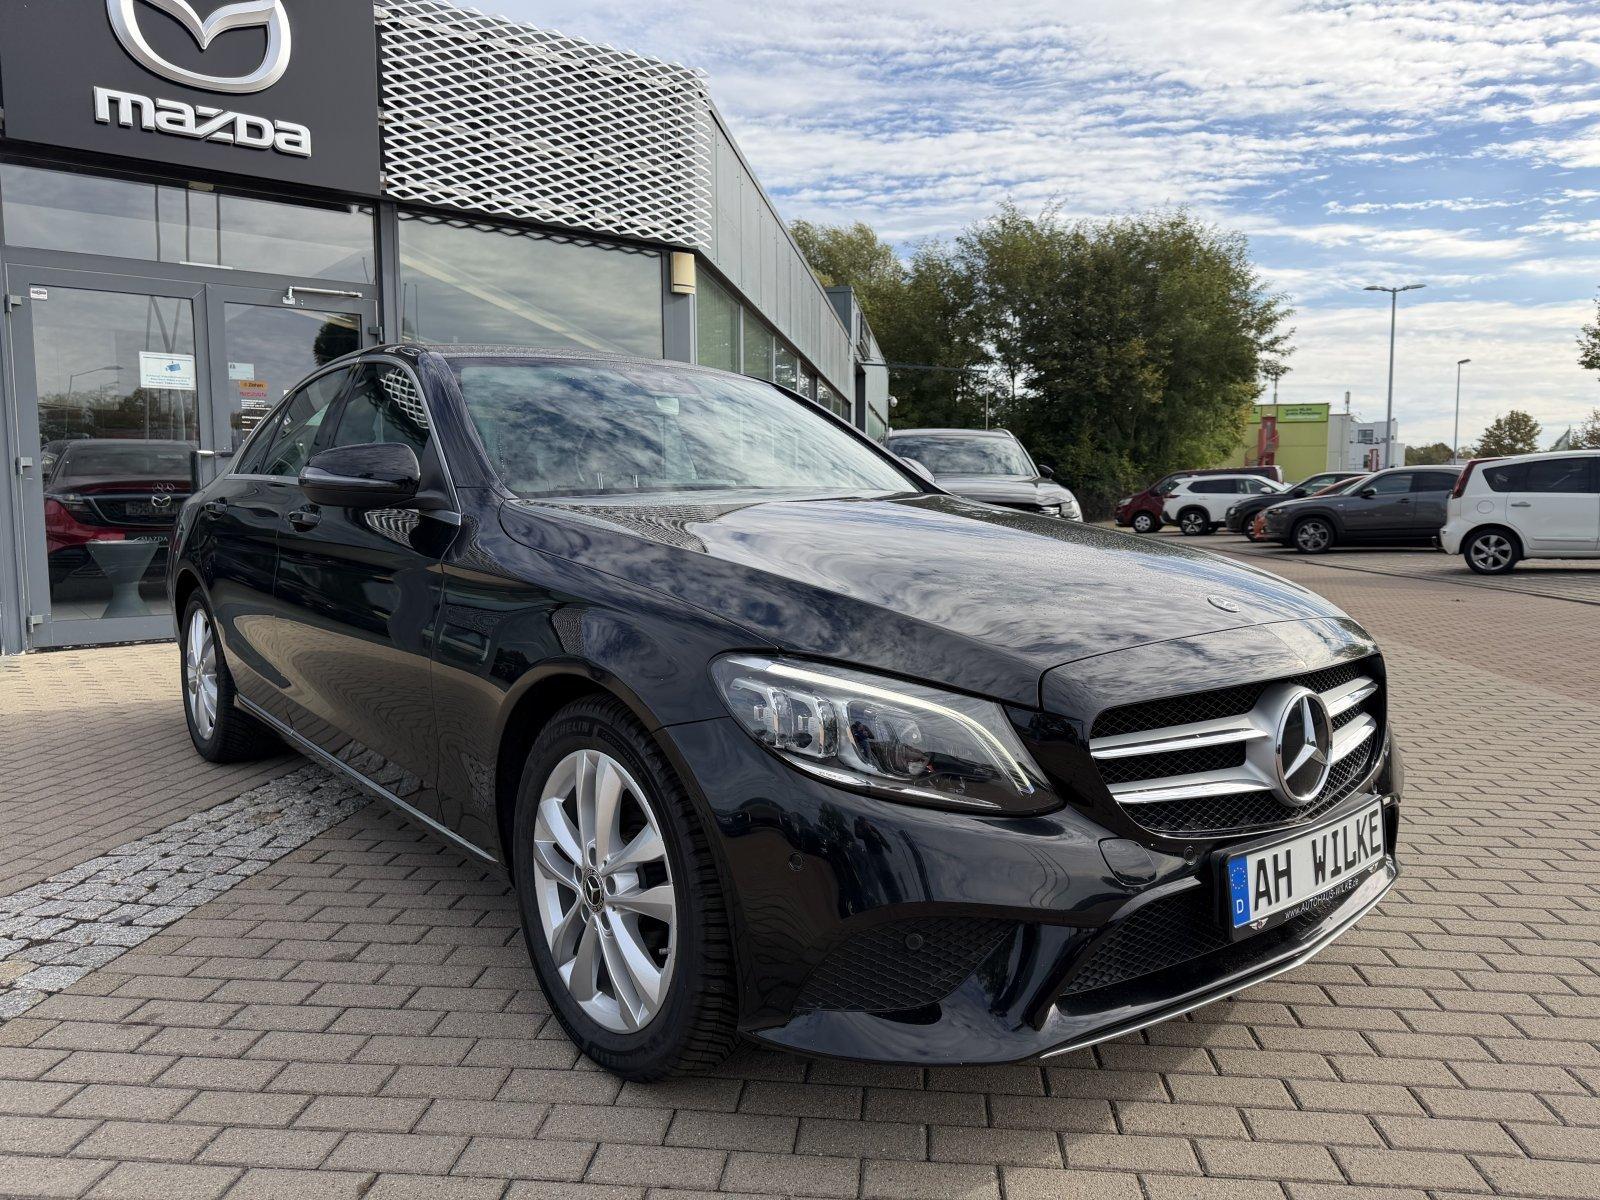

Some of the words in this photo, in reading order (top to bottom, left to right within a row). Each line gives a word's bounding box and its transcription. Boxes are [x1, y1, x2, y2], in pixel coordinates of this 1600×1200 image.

[1254, 849, 1292, 911] AH
[1312, 808, 1381, 885] WILKE
[1236, 899, 1244, 914] D
